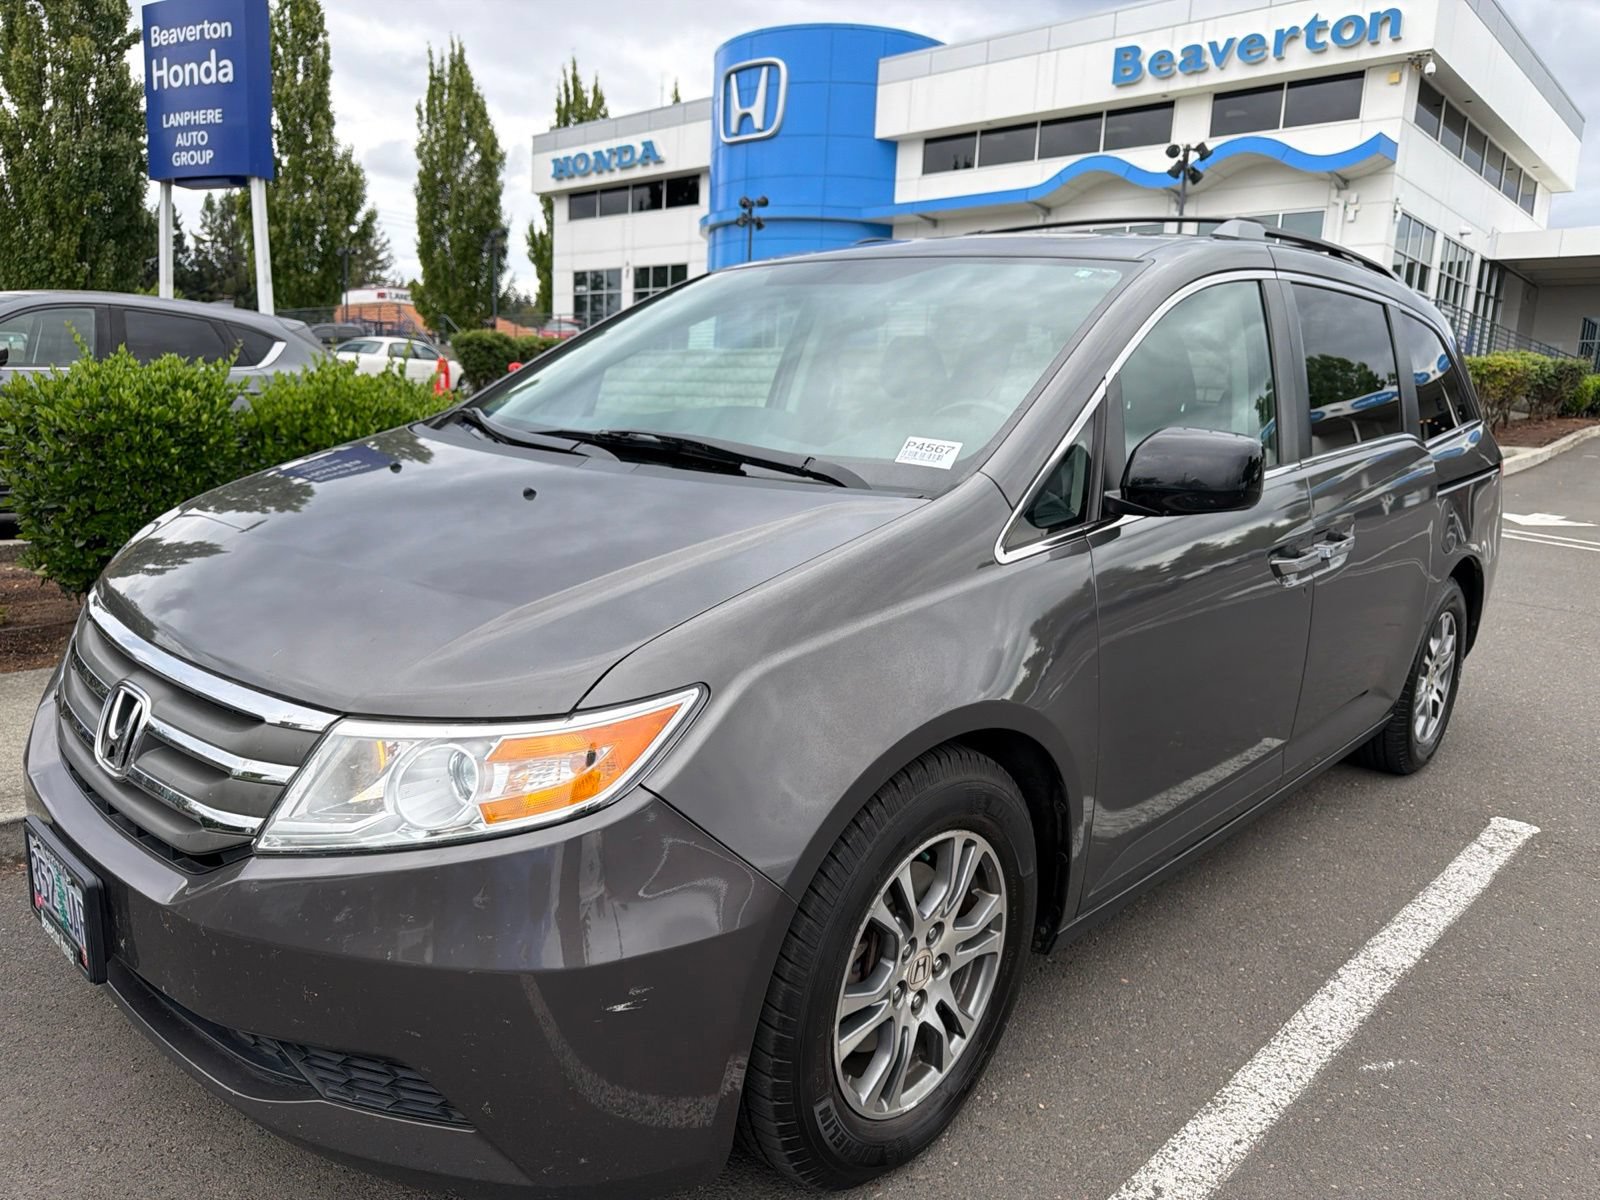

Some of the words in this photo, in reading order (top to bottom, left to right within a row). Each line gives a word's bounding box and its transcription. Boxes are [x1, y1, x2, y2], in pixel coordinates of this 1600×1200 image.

[150, 19, 232, 47] Beaverton
[1112, 7, 1402, 86] Beaverton
[152, 48, 234, 91] Honda
[162, 109, 223, 128] LANPHERE
[175, 131, 208, 147] AUTO
[172, 149, 214, 166] GROUP
[551, 140, 661, 179] HONDA
[905, 441, 956, 455] P4567
